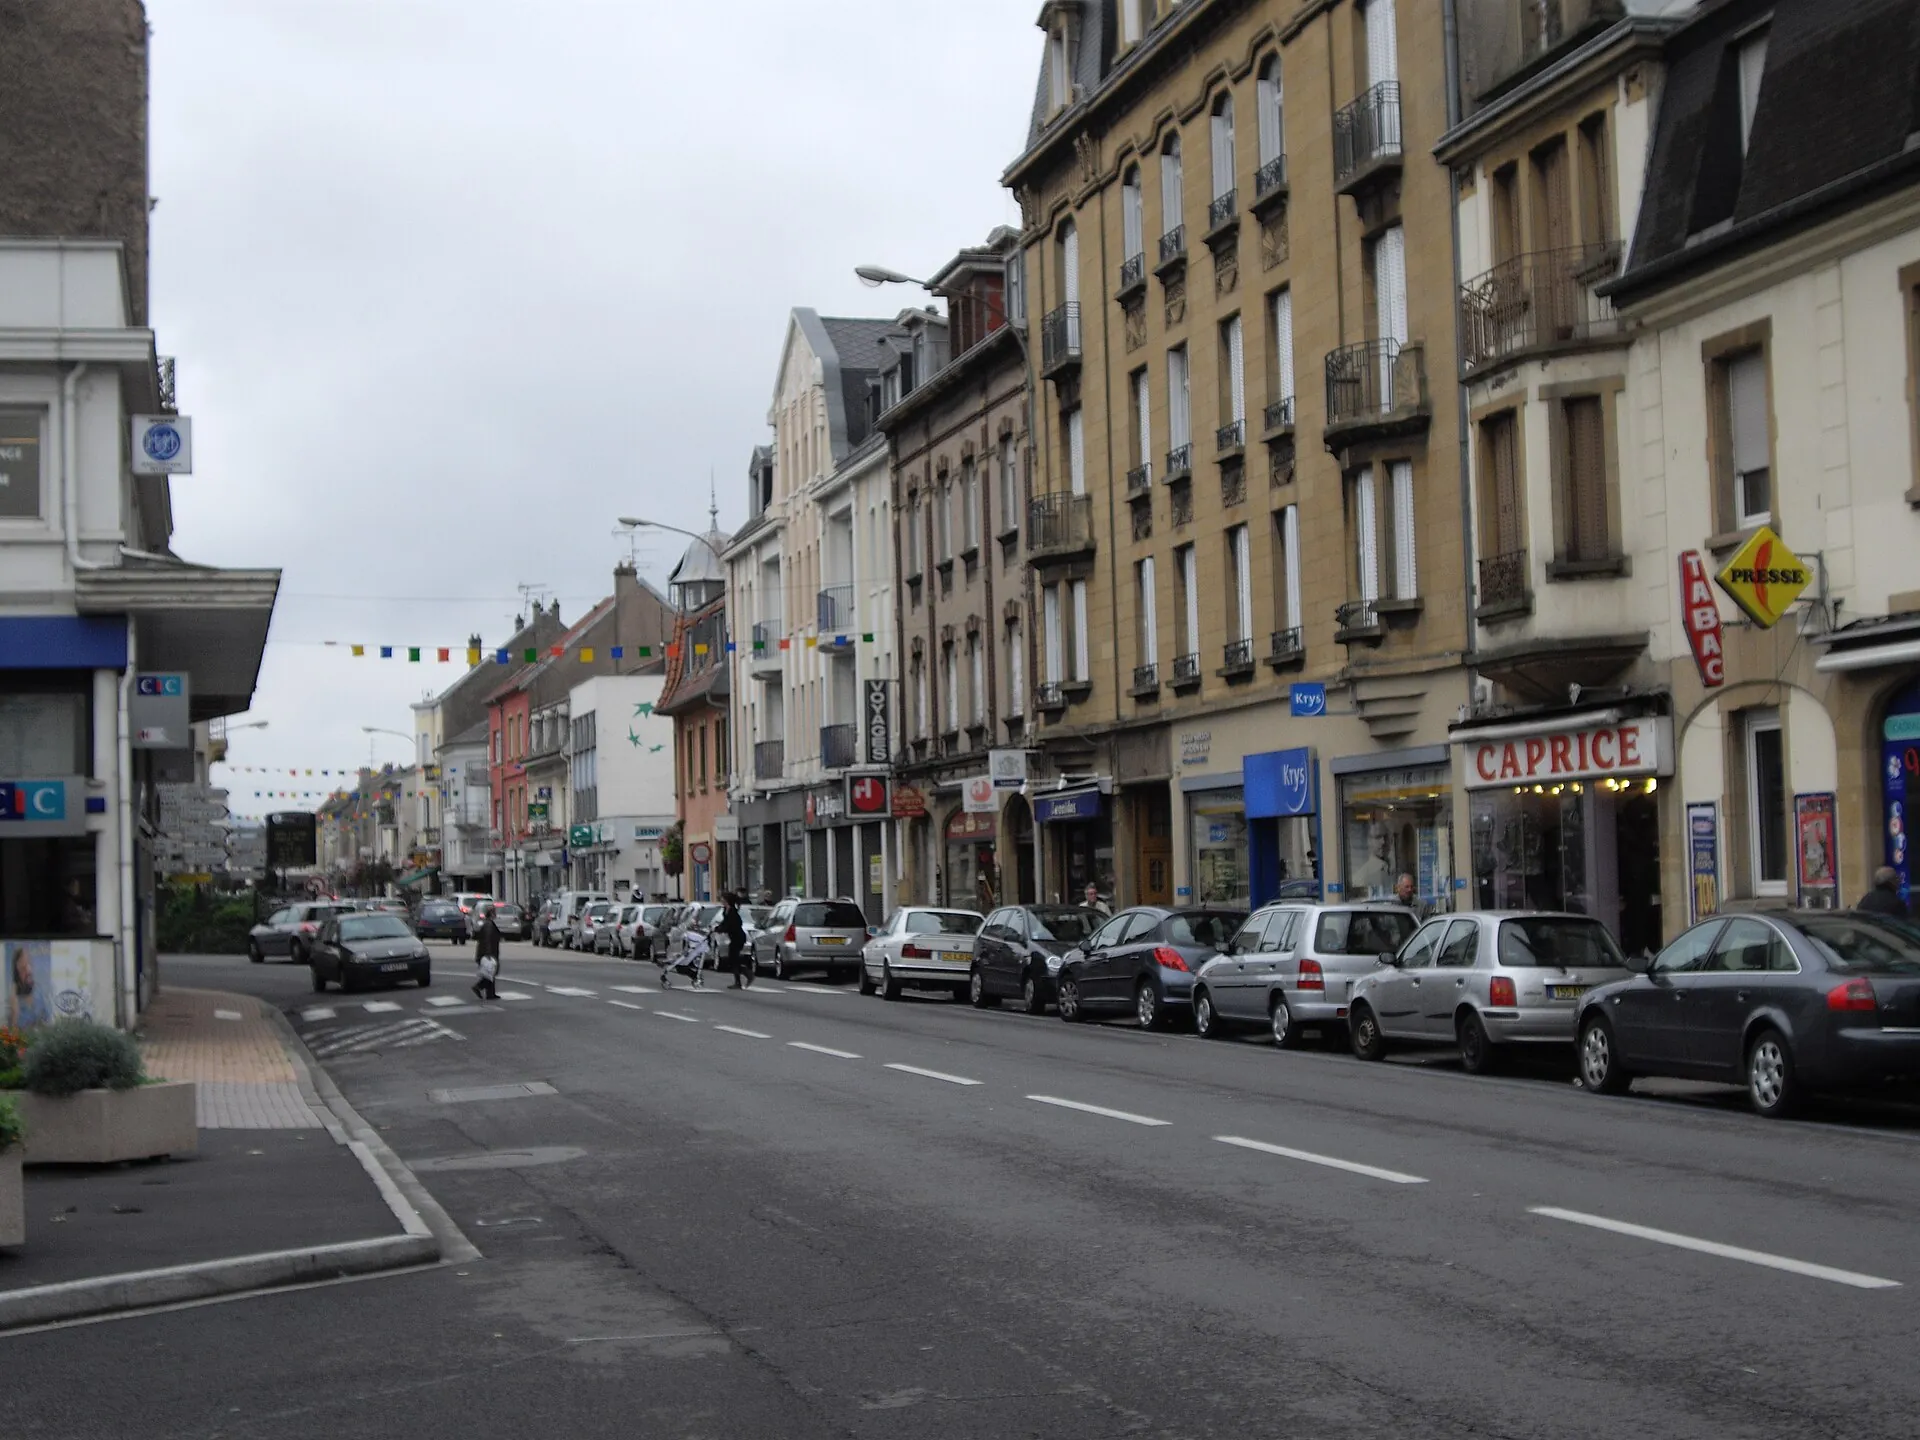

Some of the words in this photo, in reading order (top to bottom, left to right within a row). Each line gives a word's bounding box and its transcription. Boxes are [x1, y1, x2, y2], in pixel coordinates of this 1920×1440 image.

[1730, 568, 1805, 584] PRESSE
[1686, 554, 1725, 681] TABAC
[140, 678, 177, 693] CIC
[1295, 692, 1322, 708] Krys
[869, 680, 887, 762] VOYAGES
[1476, 726, 1641, 782] CAPRICE
[1283, 763, 1305, 793] Krys
